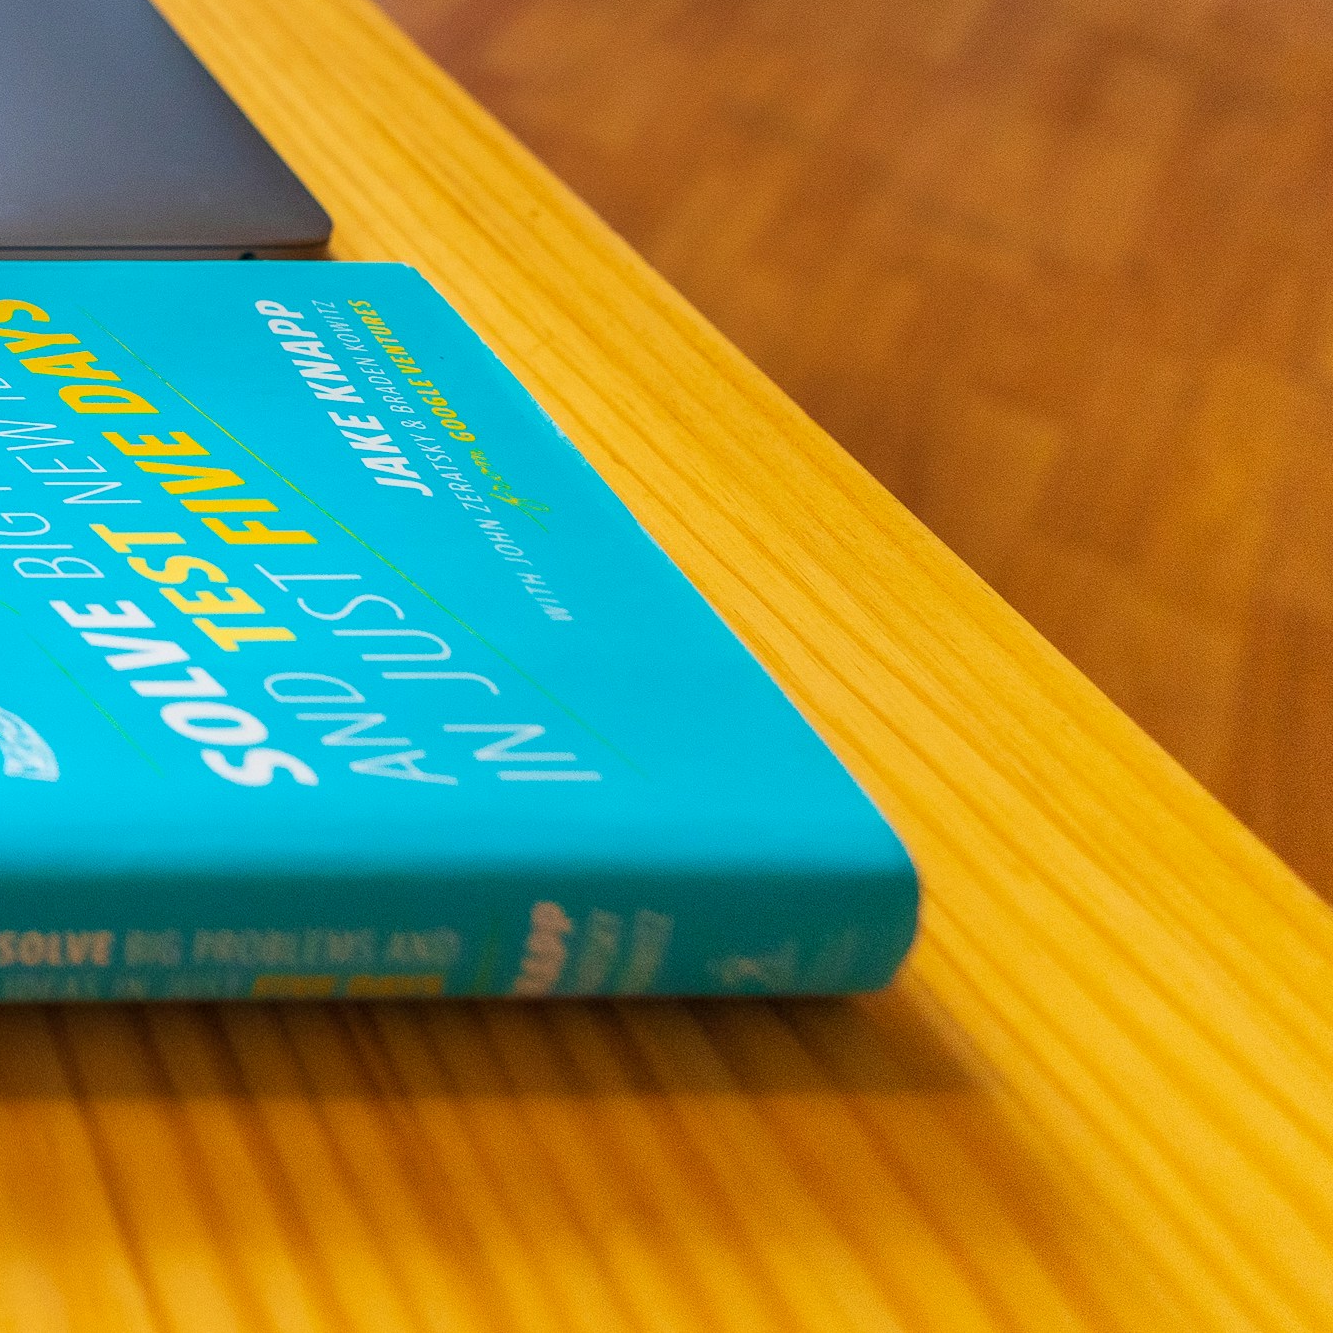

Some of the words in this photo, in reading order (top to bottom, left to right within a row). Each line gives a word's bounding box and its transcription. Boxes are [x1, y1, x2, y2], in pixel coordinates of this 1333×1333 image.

[254, 299, 366, 404] KNAPP
[310, 299, 369, 352] KOWITZ
[346, 299, 422, 374] VENTURES
[351, 356, 416, 414] BRADEN
[407, 377, 476, 443] GOOGLE
[327, 411, 434, 498] JAKE
[400, 418, 427, 431] &
[102, 431, 319, 545] FIVE
[409, 433, 493, 514] ZERATSKY
[474, 518, 534, 567] JOHN
[89, 522, 297, 653] TEST
[516, 572, 575, 622] WITH
[253, 562, 501, 697] JUST
[49, 599, 320, 787] SOLVE
[263, 671, 459, 787] AND
[442, 722, 603, 783] IN
